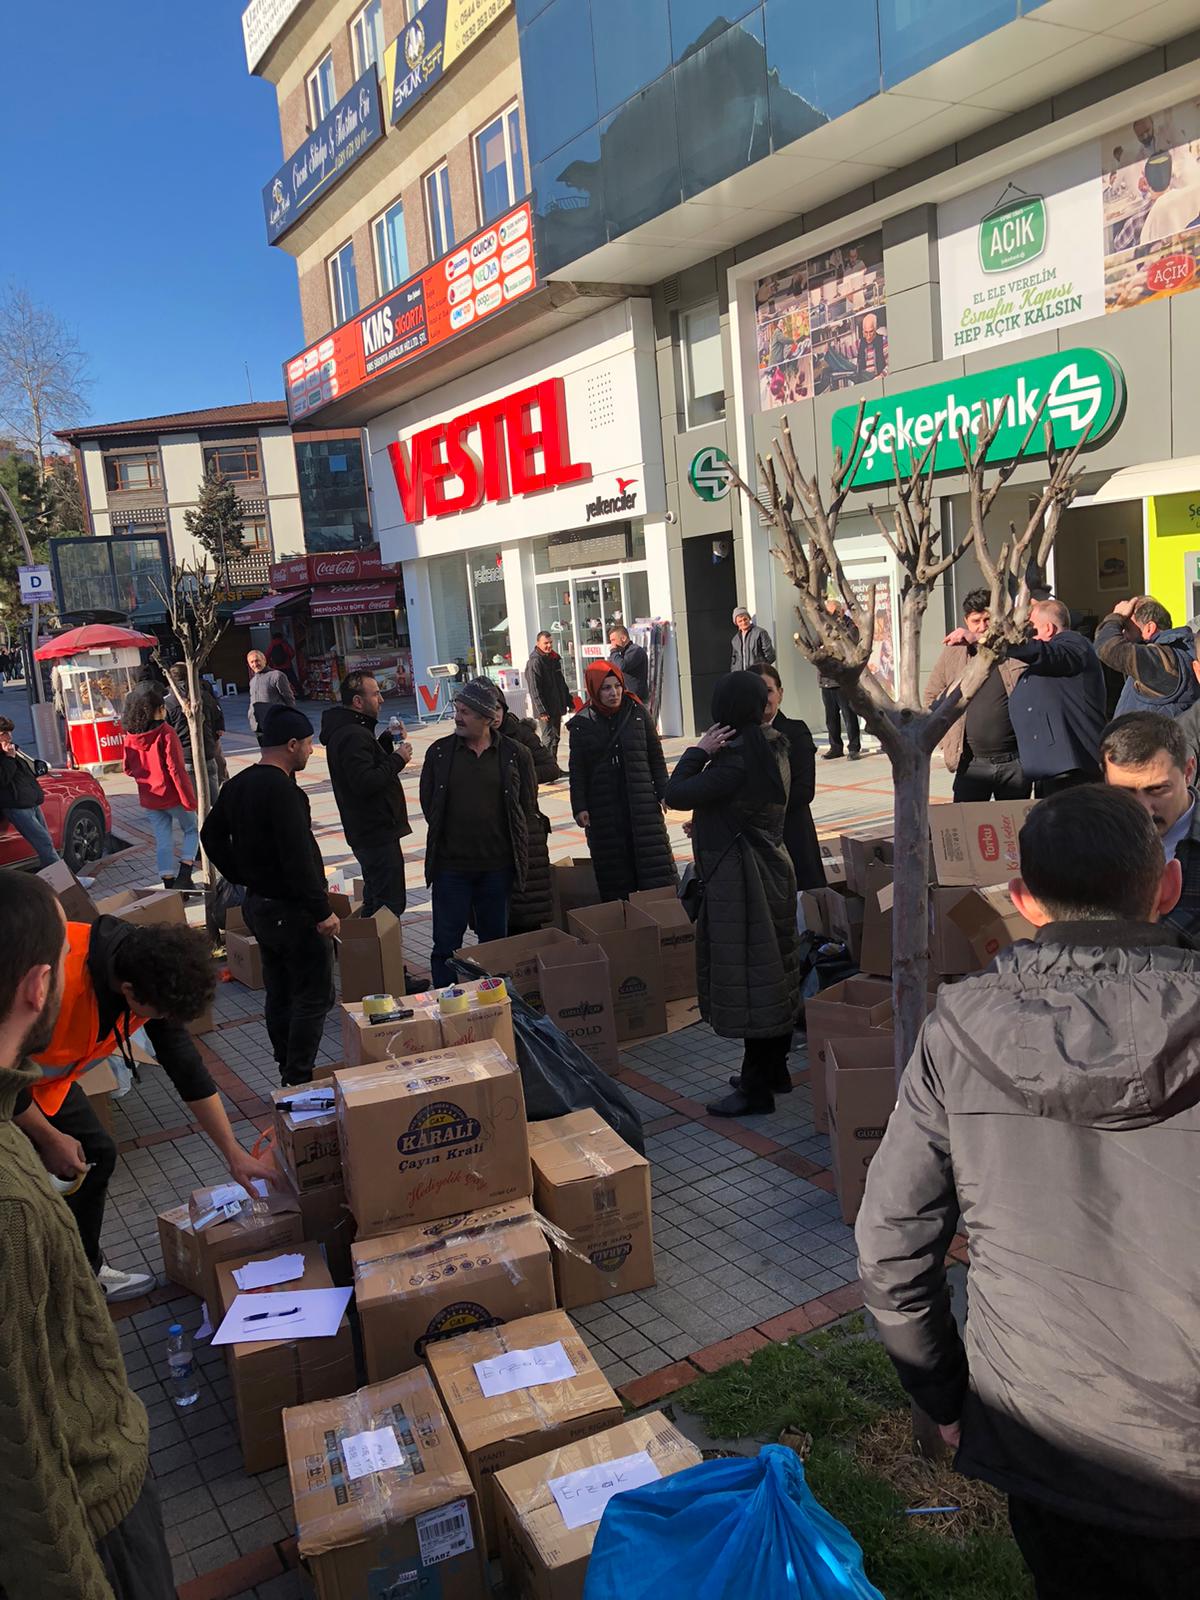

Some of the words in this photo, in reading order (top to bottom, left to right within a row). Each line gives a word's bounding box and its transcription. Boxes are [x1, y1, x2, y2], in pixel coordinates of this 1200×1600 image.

[990, 212, 1036, 257] AÇIK
[973, 292, 985, 305] EL
[987, 286, 1006, 302] ELE
[1008, 267, 1057, 296] VERELİM
[1153, 263, 1189, 287] AÇIK
[362, 305, 393, 357] KMS
[394, 303, 425, 337] SİGORTA
[954, 327, 981, 346] HEP
[984, 313, 1021, 337] AÇIK
[1024, 294, 1084, 326] KALSIN
[860, 377, 1041, 470] Şekerbank
[387, 378, 593, 524] VESTEL
[30, 576, 42, 589] D
[316, 560, 357, 577] Coca-Cola
[984, 827, 998, 857] Torku
[566, 1025, 603, 1038] GOLD
[401, 1119, 475, 1152] KARALİ
[398, 1155, 440, 1174] Çayın
[559, 1471, 628, 1501] Erzak
